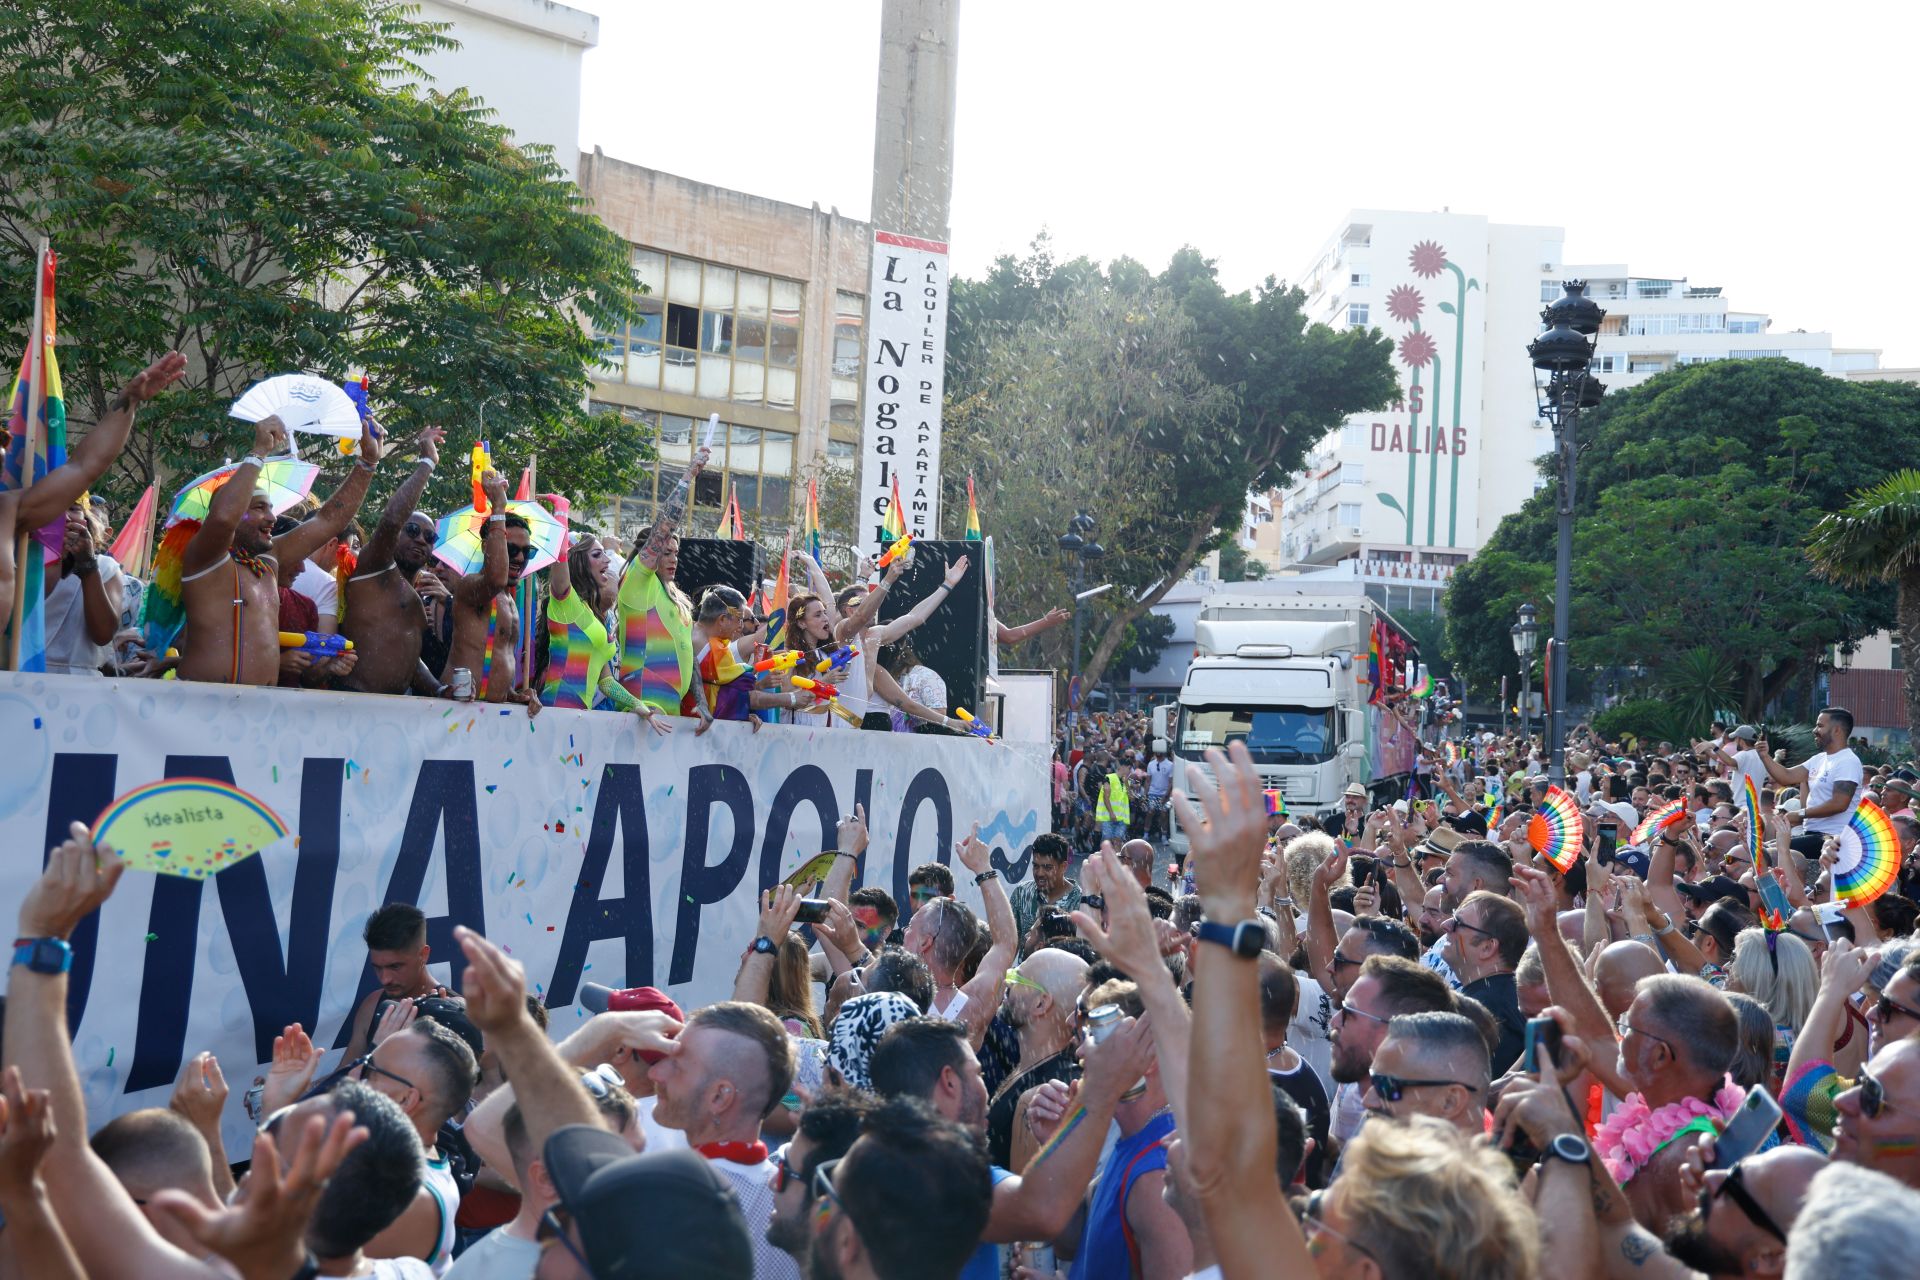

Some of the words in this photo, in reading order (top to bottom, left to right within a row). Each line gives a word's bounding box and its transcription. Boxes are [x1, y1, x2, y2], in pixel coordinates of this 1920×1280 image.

[882, 255, 908, 311] La
[922, 260, 937, 364] ALQUILER
[920, 380, 933, 404] DE
[1371, 423, 1467, 456] DALIAS
[912, 421, 930, 539] APARTAMEN
[144, 806, 224, 828] idealista
